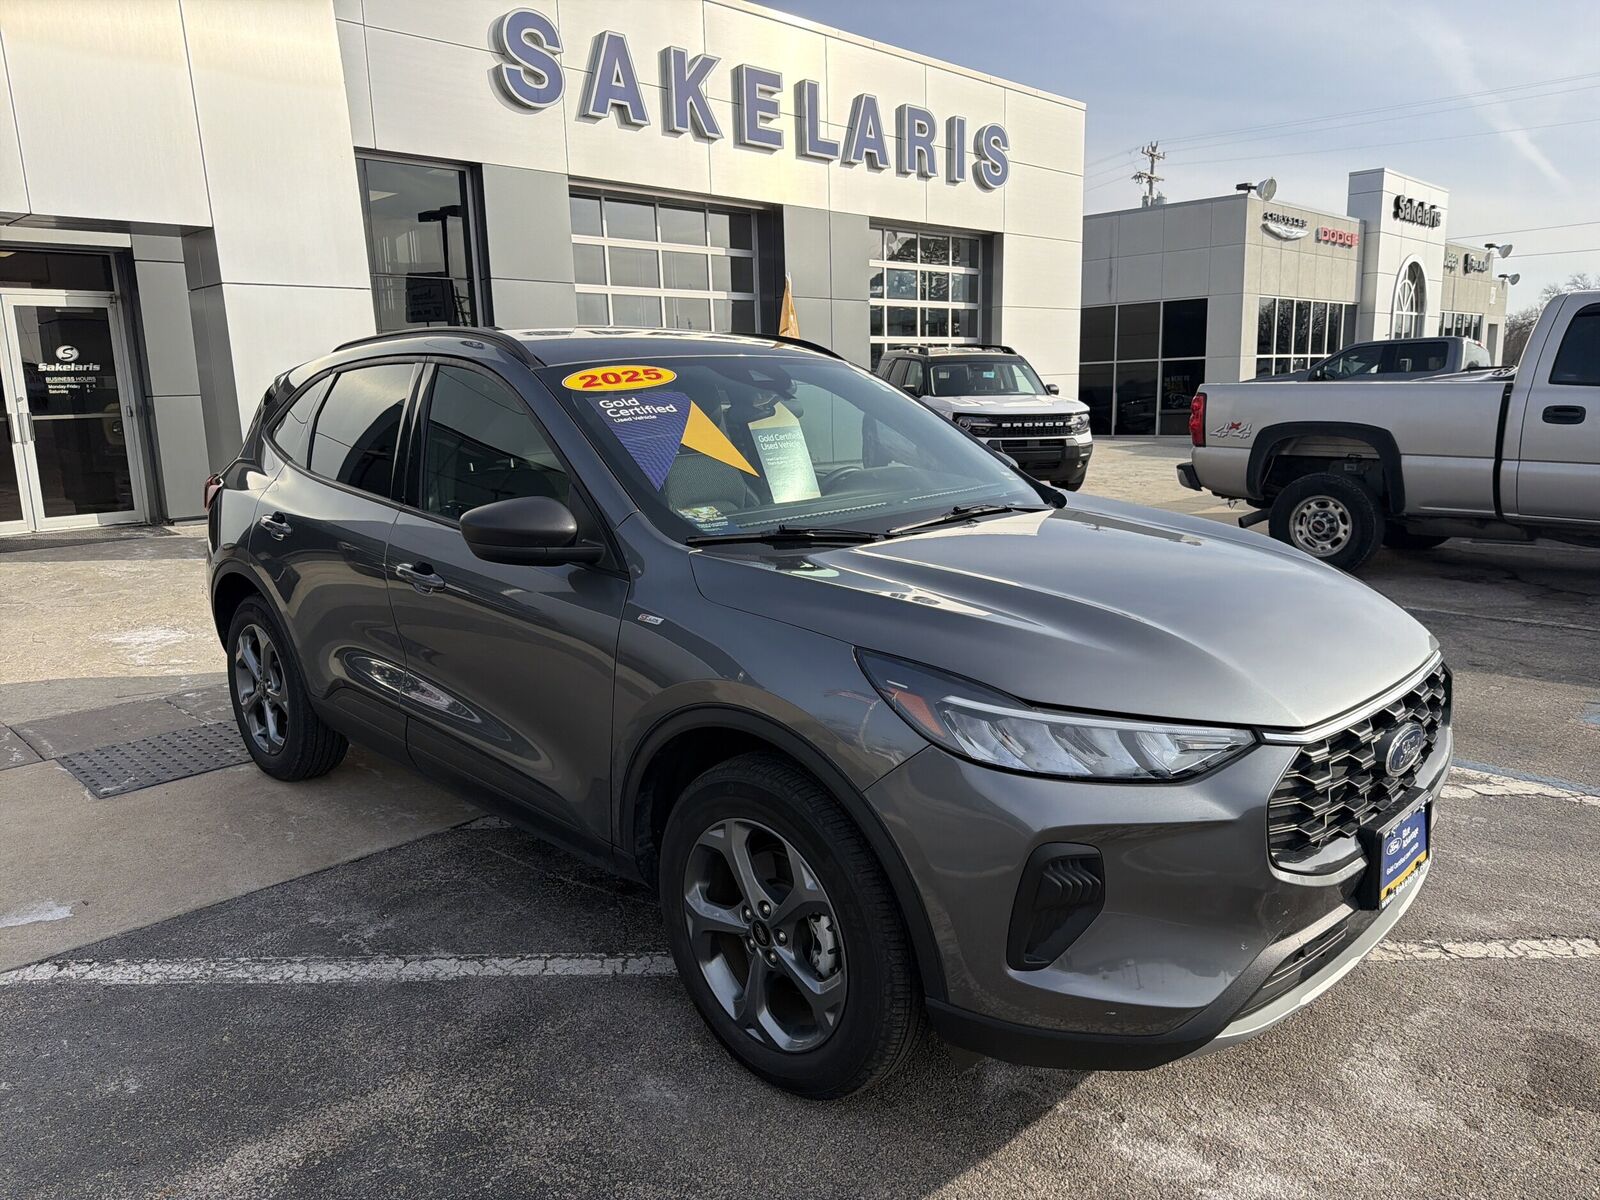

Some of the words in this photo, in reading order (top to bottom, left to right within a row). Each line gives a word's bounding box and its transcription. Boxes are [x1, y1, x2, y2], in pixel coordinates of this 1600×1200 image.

[498, 7, 1010, 190] SAKELARIS
[1394, 195, 1441, 228] Sakelaris
[1317, 227, 1359, 247] DODGE
[38, 362, 100, 372] Sakelaris
[579, 368, 664, 388] 2025
[599, 397, 640, 409] Gold
[606, 404, 678, 418] Certified
[758, 433, 775, 443] Gold
[760, 442, 779, 451] Used
